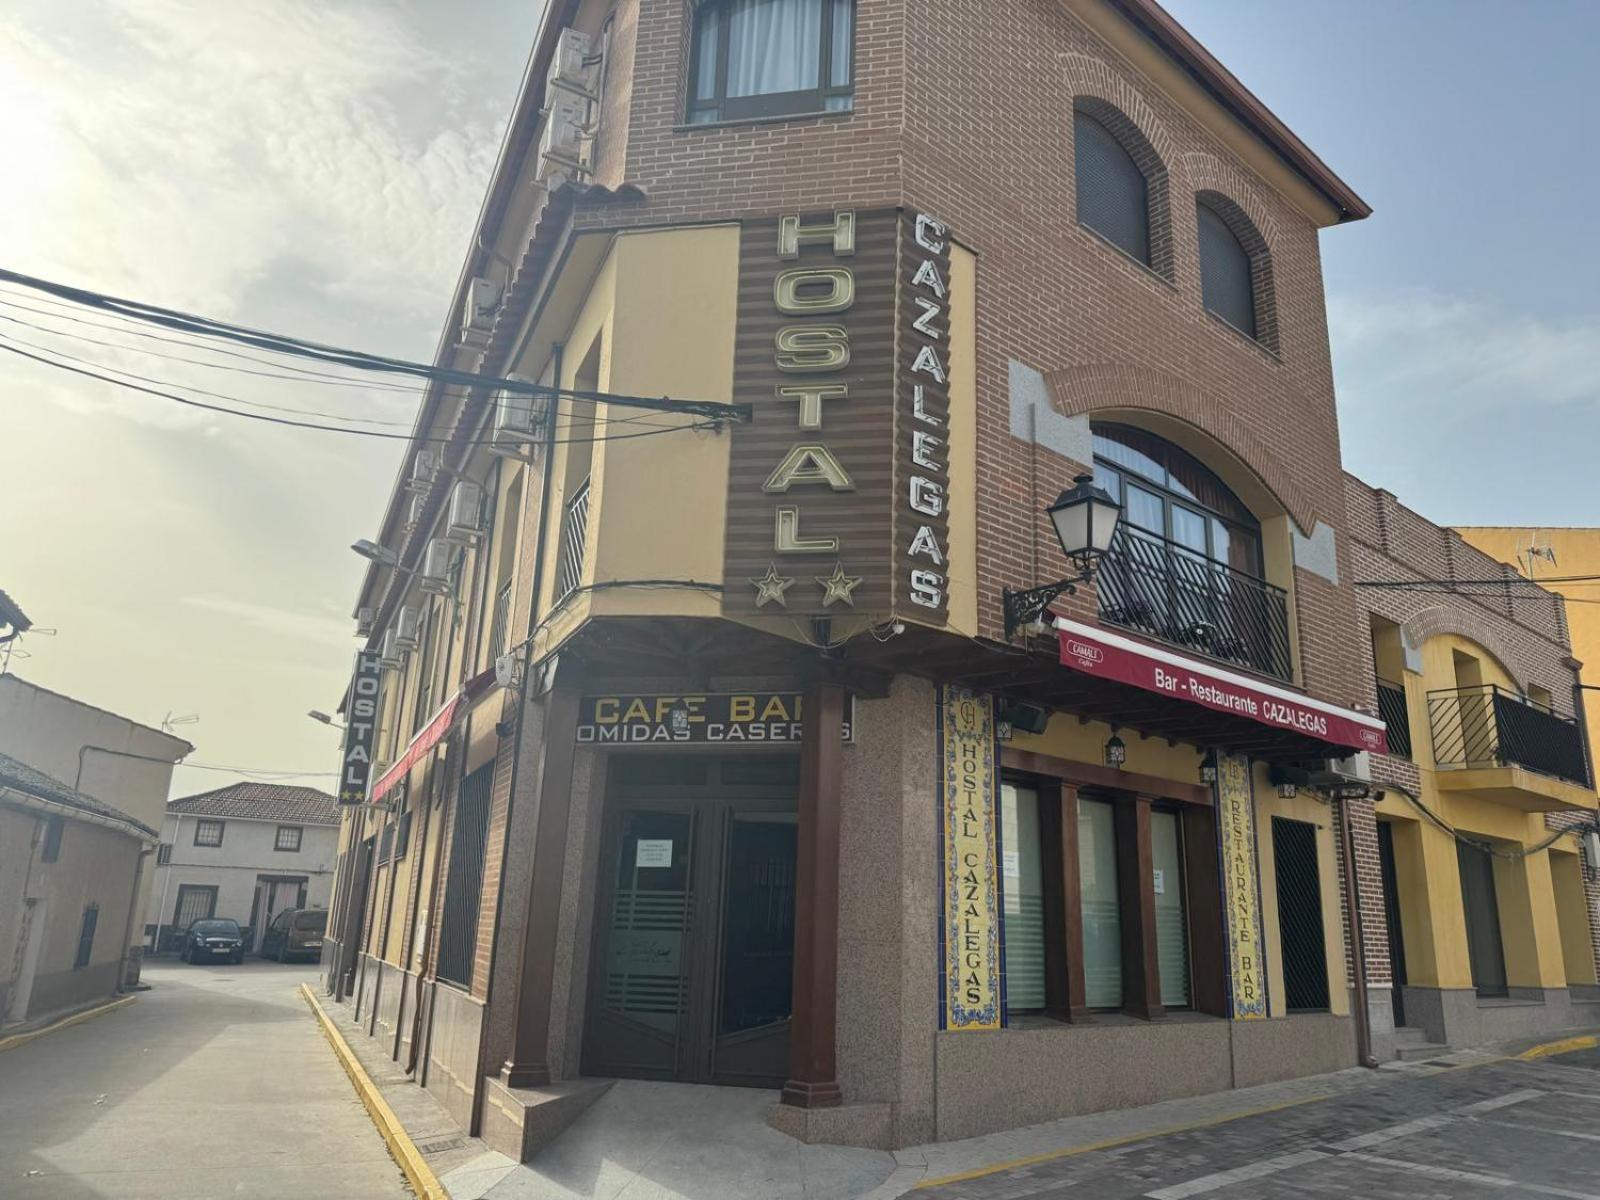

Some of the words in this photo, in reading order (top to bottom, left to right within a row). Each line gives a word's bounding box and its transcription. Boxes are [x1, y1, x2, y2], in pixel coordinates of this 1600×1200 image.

[762, 209, 855, 554] HOSTAL
[908, 213, 946, 608] CAZALEGAS
[346, 655, 381, 785] HOSTAL
[730, 695, 802, 721] BA
[1155, 667, 1177, 691] Bar
[1189, 677, 1258, 715] Restaurante
[1263, 700, 1327, 735] CAZALEGAS
[962, 743, 979, 838] HOSTAL
[964, 851, 982, 1004] CAZALEGAS
[1231, 800, 1251, 943] RESTAURANTE
[1242, 956, 1255, 1000] BAR
